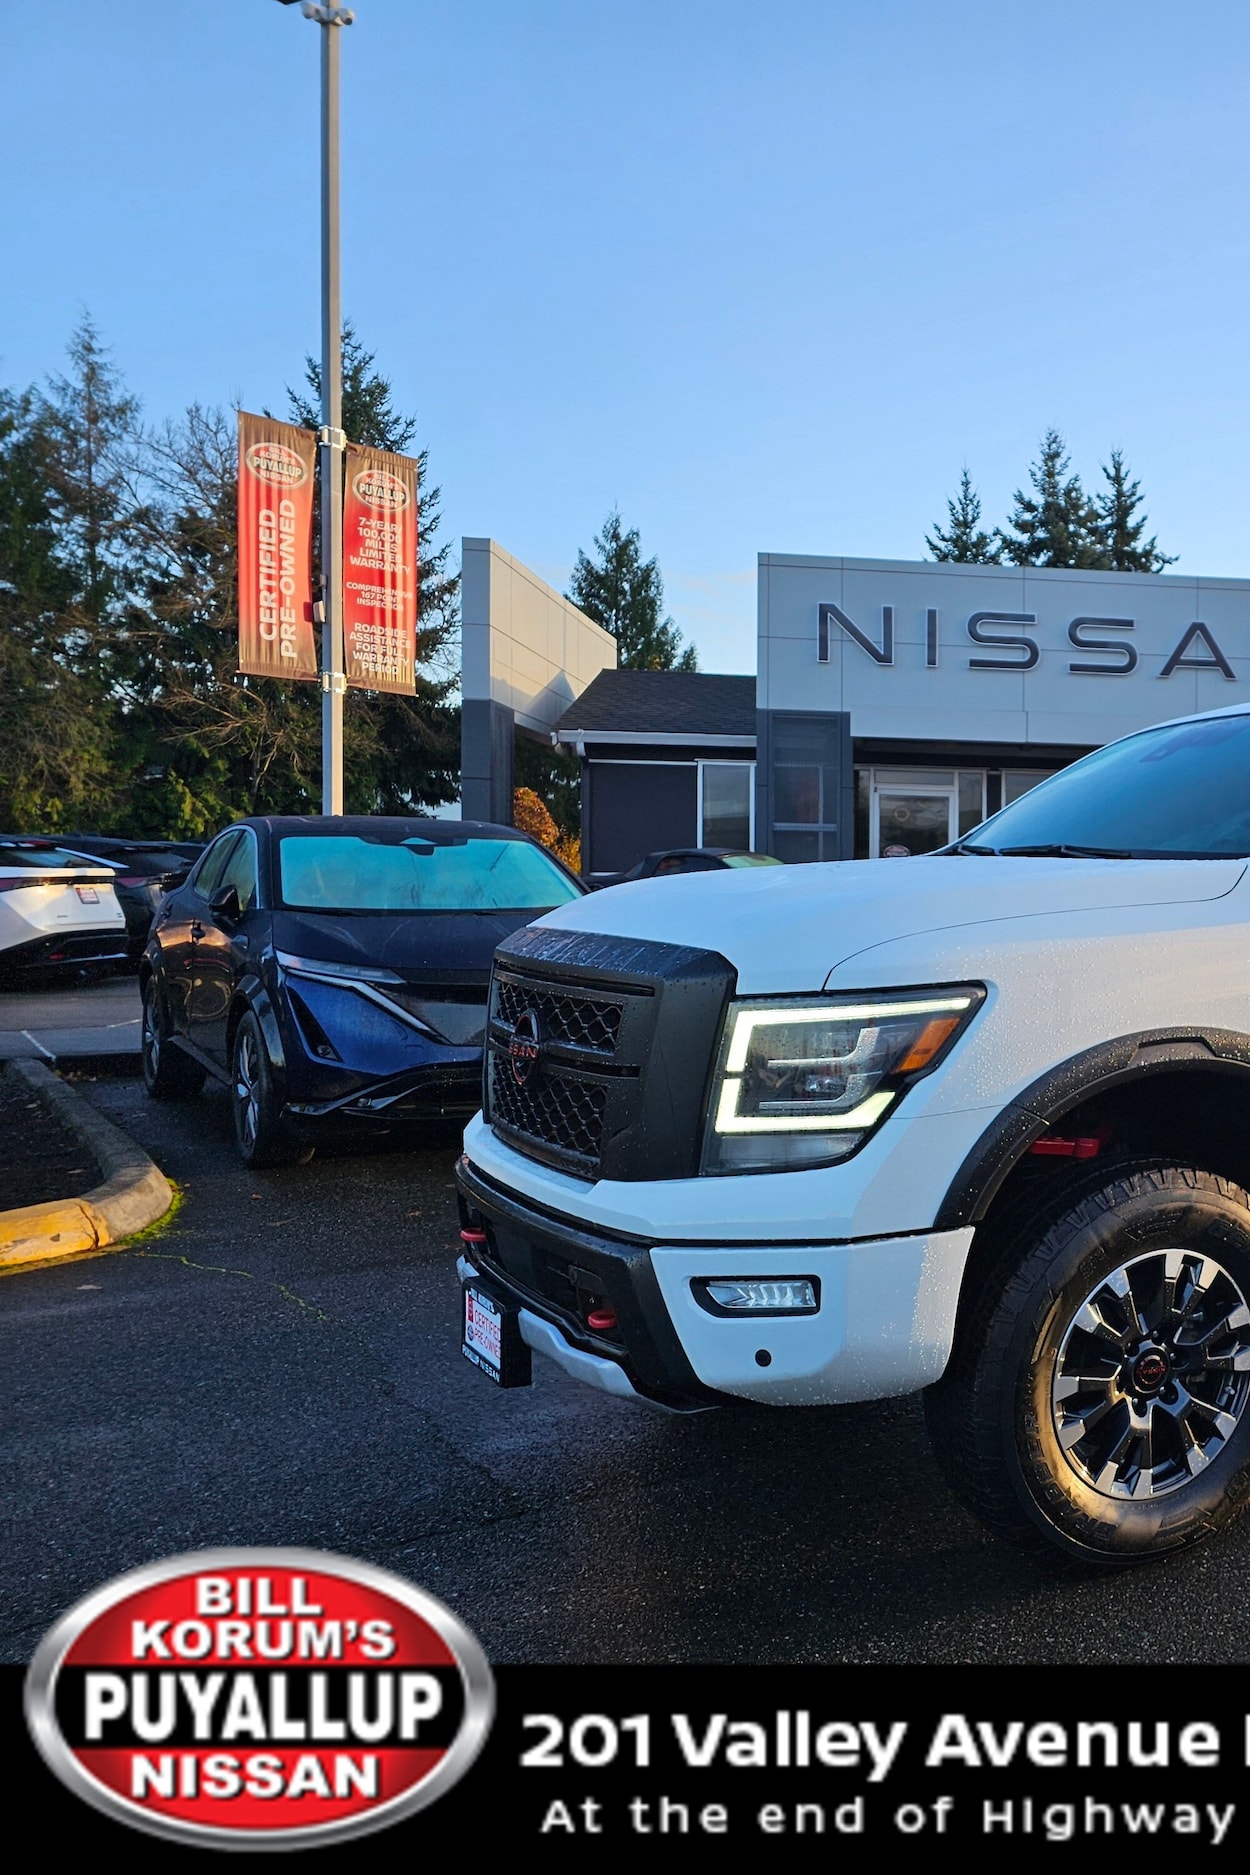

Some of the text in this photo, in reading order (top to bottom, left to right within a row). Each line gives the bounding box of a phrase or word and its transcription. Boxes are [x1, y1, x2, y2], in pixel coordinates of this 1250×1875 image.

[253, 456, 302, 478] PUYALLUP
[359, 482, 405, 502] PUYALLUP
[365, 539, 398, 552] MILES
[360, 547, 402, 564] LIMITED
[350, 555, 411, 575] WARRANTY
[259, 509, 277, 641] CERTIFIED
[280, 499, 297, 659] PRE-OWNED
[361, 591, 375, 600] 167
[354, 622, 408, 639] ROADSIDE
[349, 631, 412, 649] ASSISTANCE
[356, 642, 405, 657] FOR FULL
[352, 650, 410, 667] WARRANTY
[361, 661, 399, 675] PERIOD
